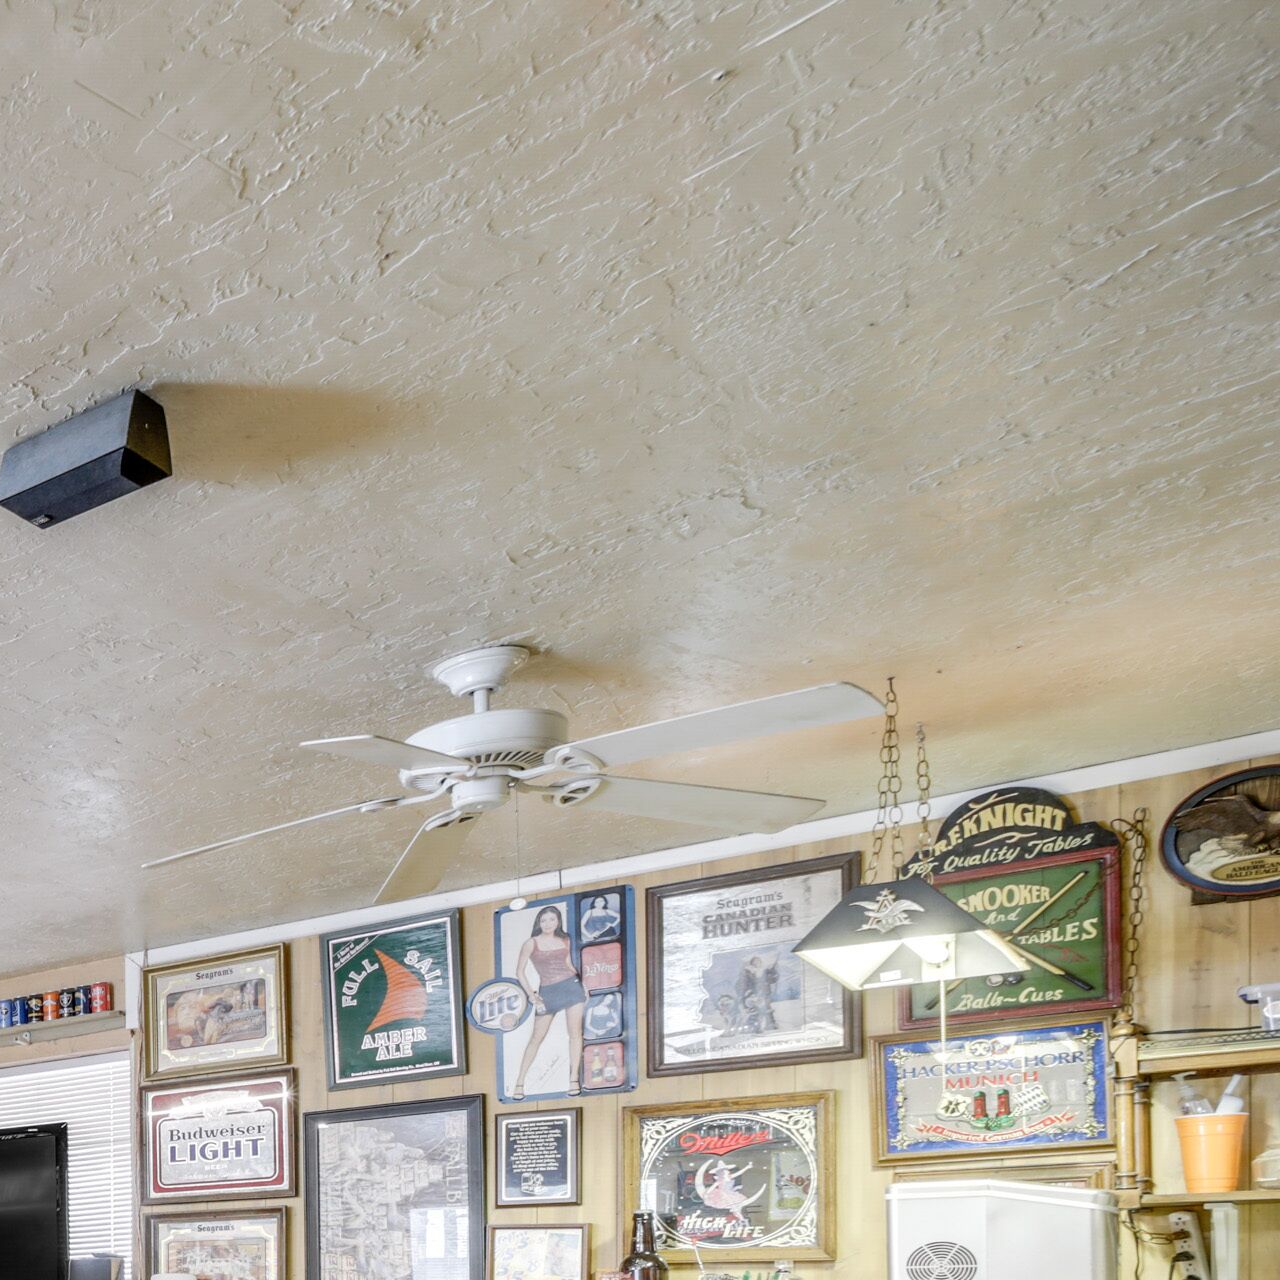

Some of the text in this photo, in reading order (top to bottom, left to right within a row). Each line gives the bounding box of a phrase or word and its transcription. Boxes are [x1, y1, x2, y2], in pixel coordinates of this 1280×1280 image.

[963, 803, 1067, 839] KNIGHT
[941, 847, 1021, 872] Quality
[1025, 833, 1095, 859] Tables
[717, 891, 783, 910] Seagram's
[956, 884, 1051, 912] SNOOKER
[702, 902, 793, 924] CANADIAN
[984, 908, 1021, 925] And
[702, 914, 793, 939] HUNTER
[1018, 918, 1099, 945] TABLES
[196, 968, 234, 981] Seagram's
[342, 959, 379, 1008] FULL
[404, 950, 443, 993] SAIL
[477, 994, 520, 1023] Lite
[361, 1027, 427, 1049] AMBER
[376, 1044, 413, 1061] ALE
[901, 1051, 1085, 1079] HACKER-PSCHORR
[944, 1071, 1040, 1091] MUNICH
[169, 1123, 265, 1142] Budweiser
[679, 1130, 771, 1156] Miller
[943, 1129, 985, 1142] Imported
[986, 1130, 1023, 1142] German
[168, 1138, 265, 1164] LIGHT
[196, 1224, 235, 1233] Seagram's
[682, 1211, 727, 1230] HIGH
[723, 1224, 764, 1238] LIFE
